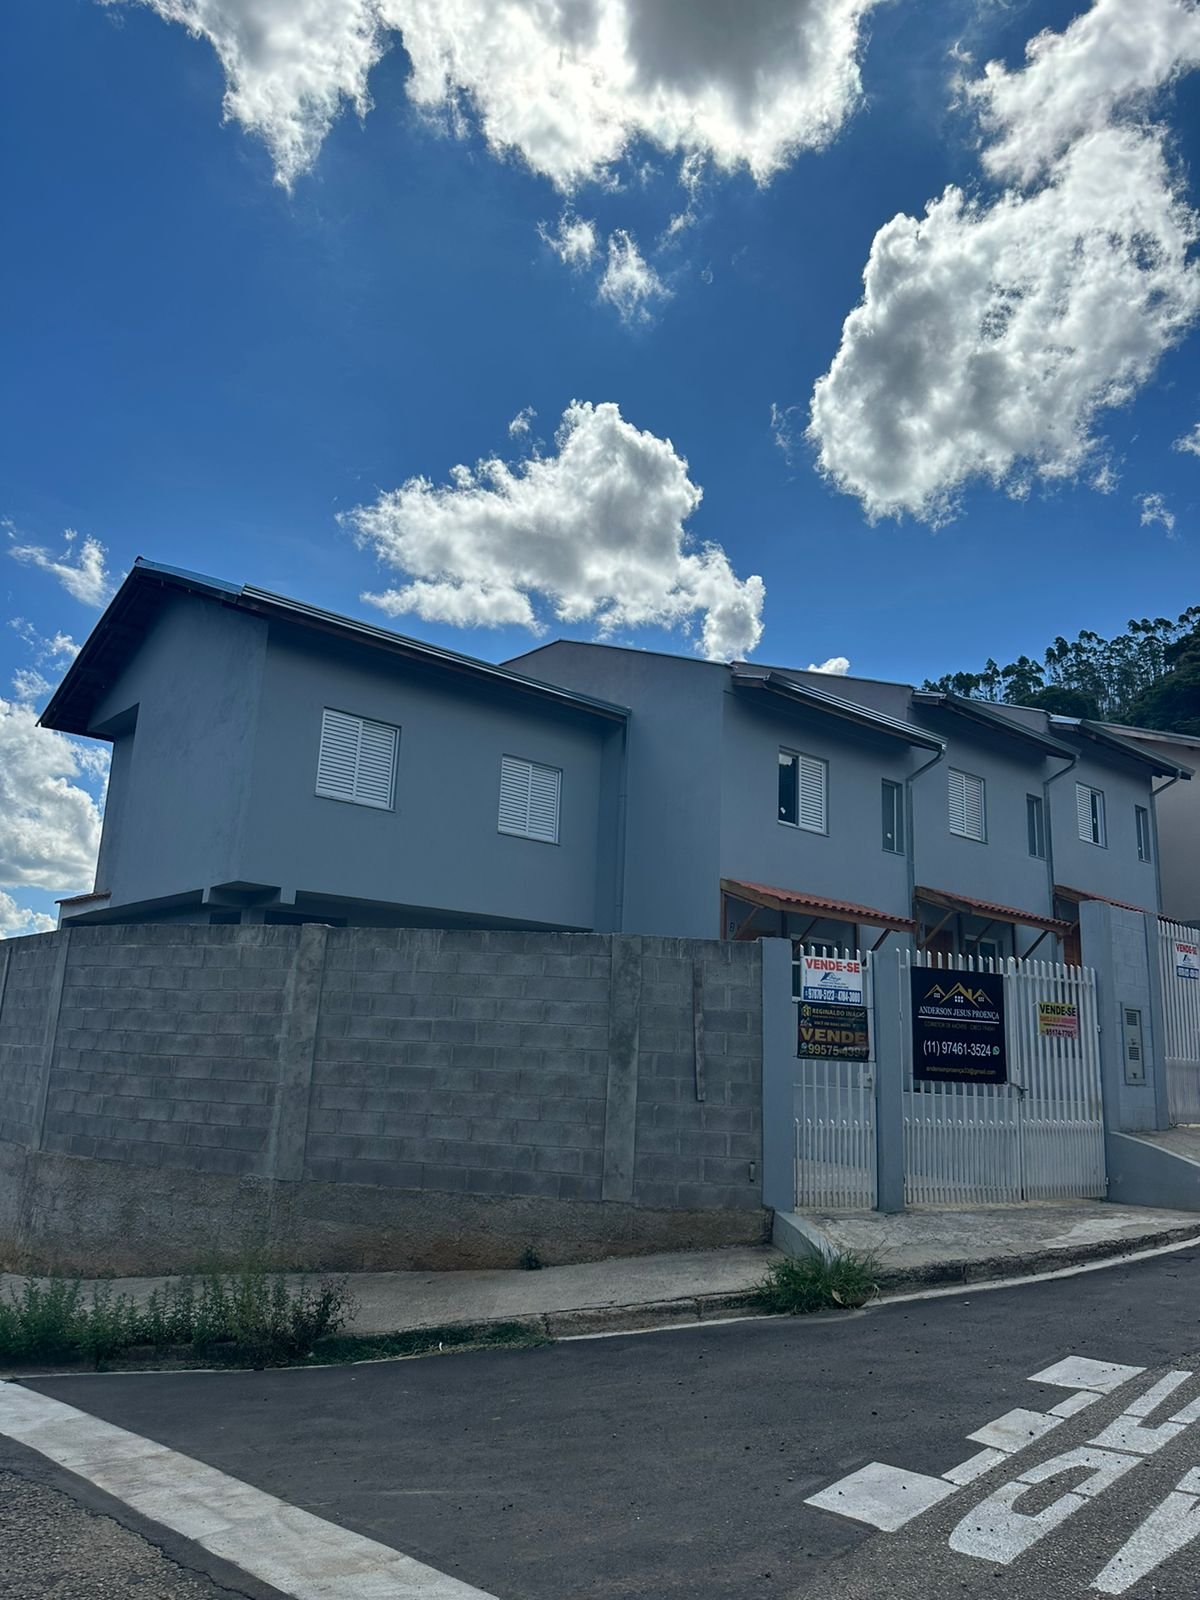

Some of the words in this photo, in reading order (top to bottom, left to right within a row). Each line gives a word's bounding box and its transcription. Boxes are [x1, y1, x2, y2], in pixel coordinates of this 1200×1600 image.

[805, 958, 860, 973] VENDE-SE
[919, 1006, 952, 1016] ANDERSON
[953, 1008, 971, 1017] JESUS
[971, 1010, 999, 1020] PROENÇA
[1040, 1003, 1076, 1017] VENDE-SE
[800, 1027, 866, 1044] VENDE
[923, 1040, 940, 1056] (11)
[941, 1041, 991, 1056] 97461-3524
